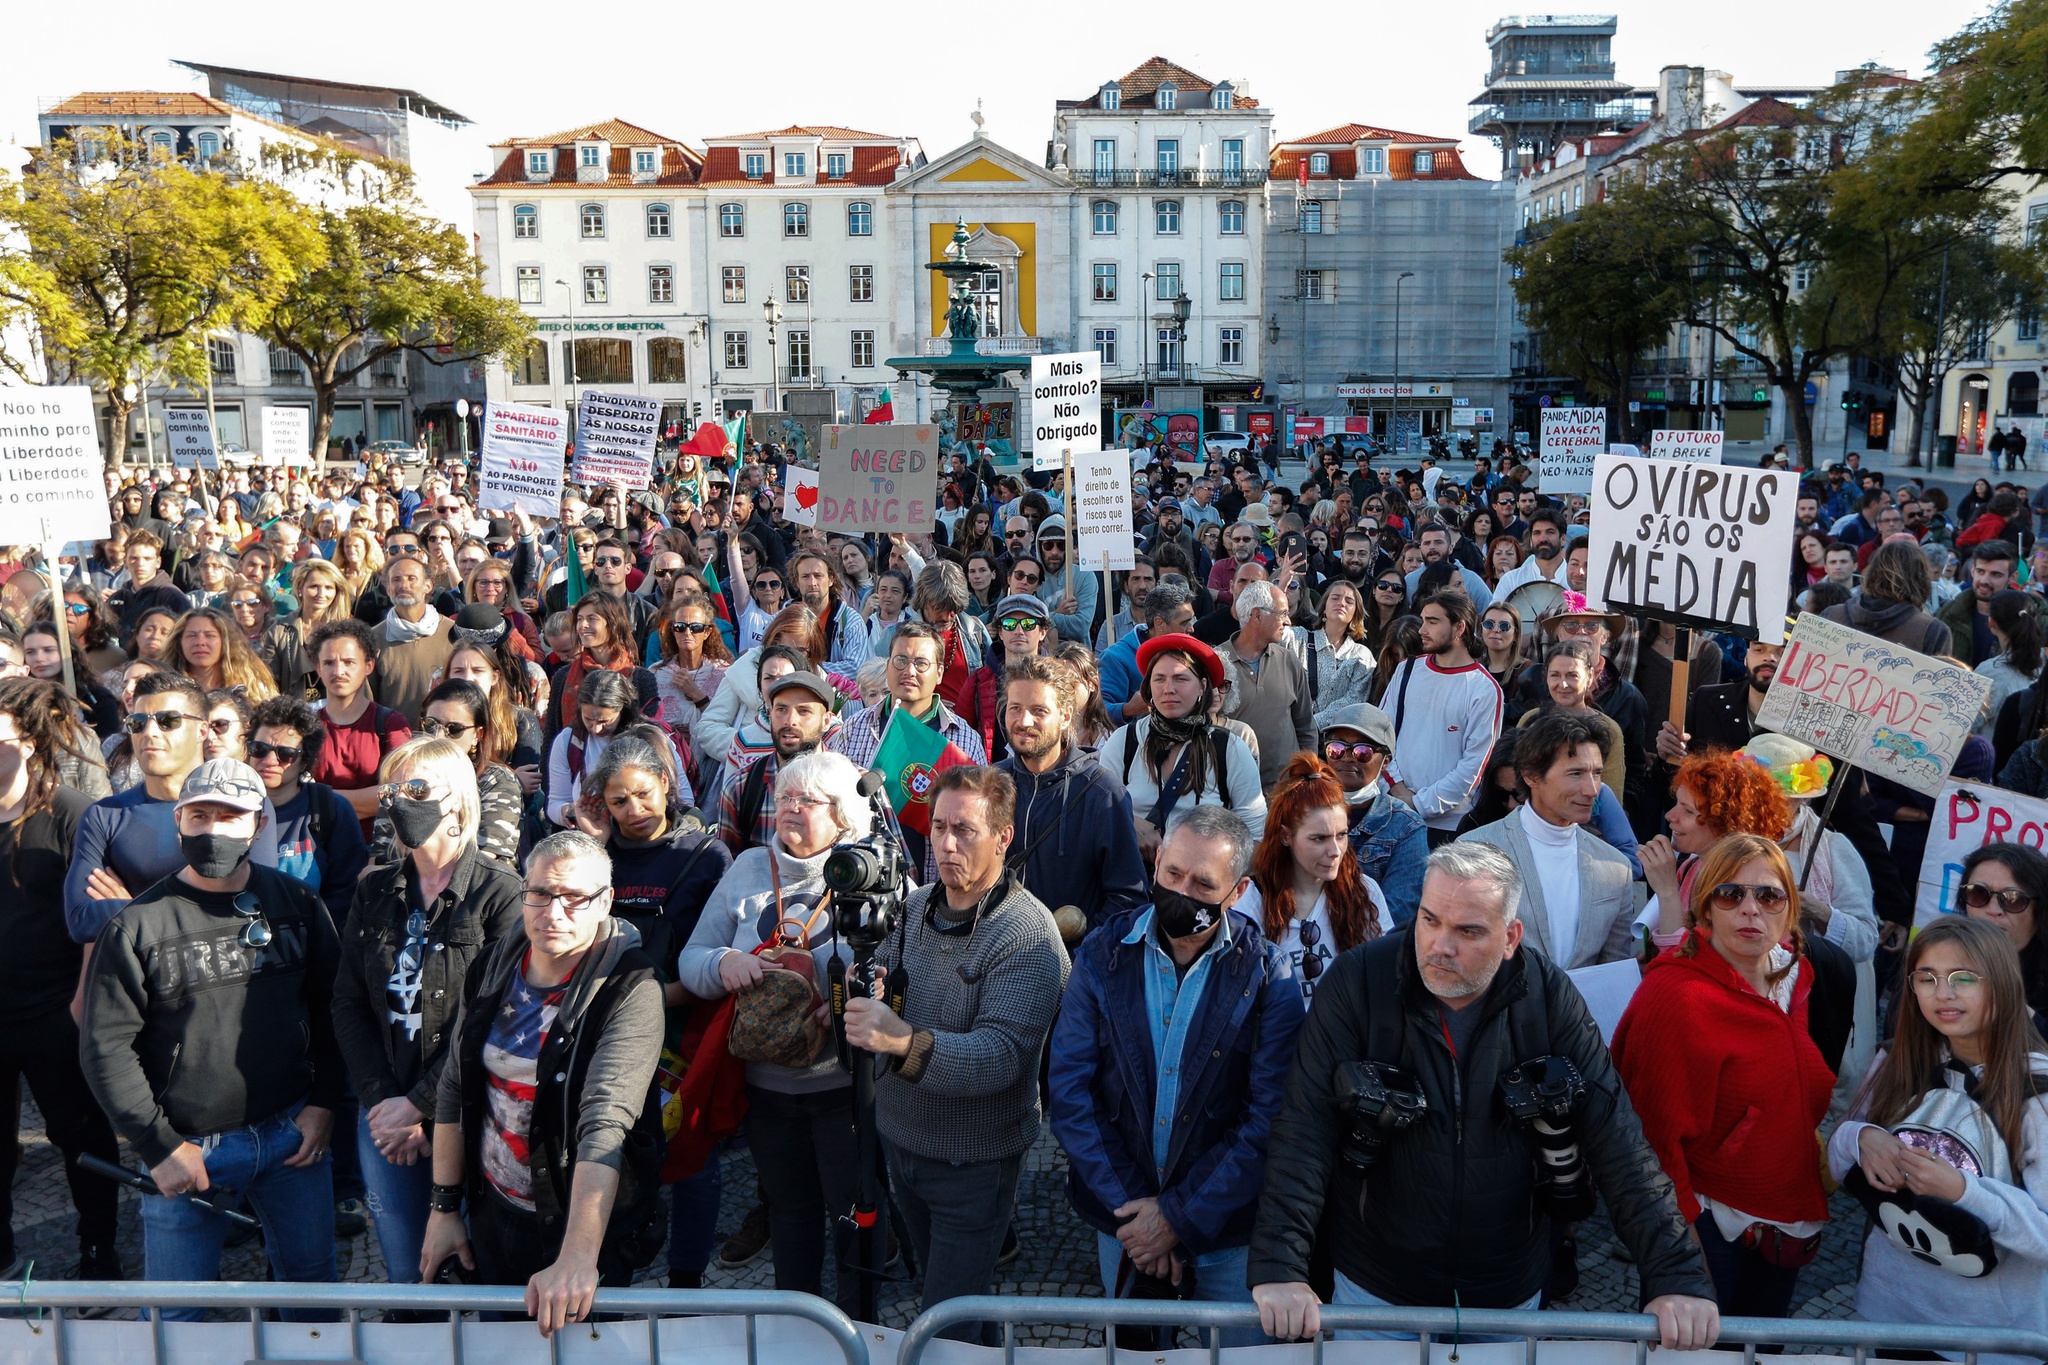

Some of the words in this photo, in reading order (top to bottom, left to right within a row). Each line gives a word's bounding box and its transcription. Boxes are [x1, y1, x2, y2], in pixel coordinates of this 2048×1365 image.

[563, 322, 600, 331] COLORS
[601, 322, 615, 331] OF
[1050, 361, 1083, 376] Mais
[1034, 380, 1098, 399] controlo?
[1336, 386, 1357, 394] feira
[1359, 386, 1376, 394] dos
[1379, 386, 1413, 394] tecdos
[3, 402, 35, 415] Não
[590, 394, 647, 408] DEVOLVAM
[169, 411, 188, 420] Sim
[587, 406, 655, 421] DESPORTO
[1054, 402, 1080, 418] Não
[495, 410, 560, 427] APARTHEID
[585, 416, 601, 428] ÀS
[604, 421, 653, 434] NOSSAS
[56, 424, 91, 439] para
[168, 423, 210, 432] caminho
[495, 423, 557, 440] SANITÁRIO
[1036, 422, 1097, 441] Obrigado
[1545, 425, 1600, 435] LAVAGEM
[186, 435, 198, 444] do
[588, 433, 638, 445] CRIANÇAS
[1547, 436, 1603, 447] CEREBRAL
[1655, 431, 1664, 442] O
[1667, 431, 1721, 444] FUTURO
[175, 446, 213, 458] coração
[595, 447, 636, 457] JOVENS!
[1652, 447, 1666, 457] EM
[1672, 447, 1712, 458] BREVE
[508, 457, 538, 472] NÃO
[577, 455, 602, 463] CHEGA
[614, 459, 649, 468] DEBILITAR
[851, 448, 926, 473] NEED
[9, 466, 90, 481] Liberdade
[613, 466, 640, 476] FÍSICA
[1091, 466, 1112, 477] Tenho
[502, 472, 557, 486] PASAPORTE
[1085, 480, 1109, 492] direito
[1110, 480, 1120, 490] de
[10, 493, 19, 503] o
[26, 488, 94, 503] caminho
[487, 481, 500, 490] DE
[502, 483, 555, 498] VACINAÇÃO
[1604, 462, 1638, 511] O
[1648, 464, 1778, 526] VÍRUS
[1083, 495, 1113, 507] escolher
[1115, 495, 1124, 504] os
[822, 497, 925, 525] DANCE
[1085, 510, 1107, 520] riscos
[1109, 510, 1123, 521] que
[1080, 525, 1100, 536] quero
[1101, 524, 1131, 533] correr...
[1636, 513, 1690, 547] SÃO
[1704, 523, 1743, 553] OS
[1602, 540, 1758, 630] MÉDIA
[1777, 641, 1942, 738] LIBERDADE
[1948, 794, 2048, 850] PRO
[148, 922, 308, 995] URBAN
[832, 982, 842, 1014] Nikon
[892, 994, 903, 1014] Nik
